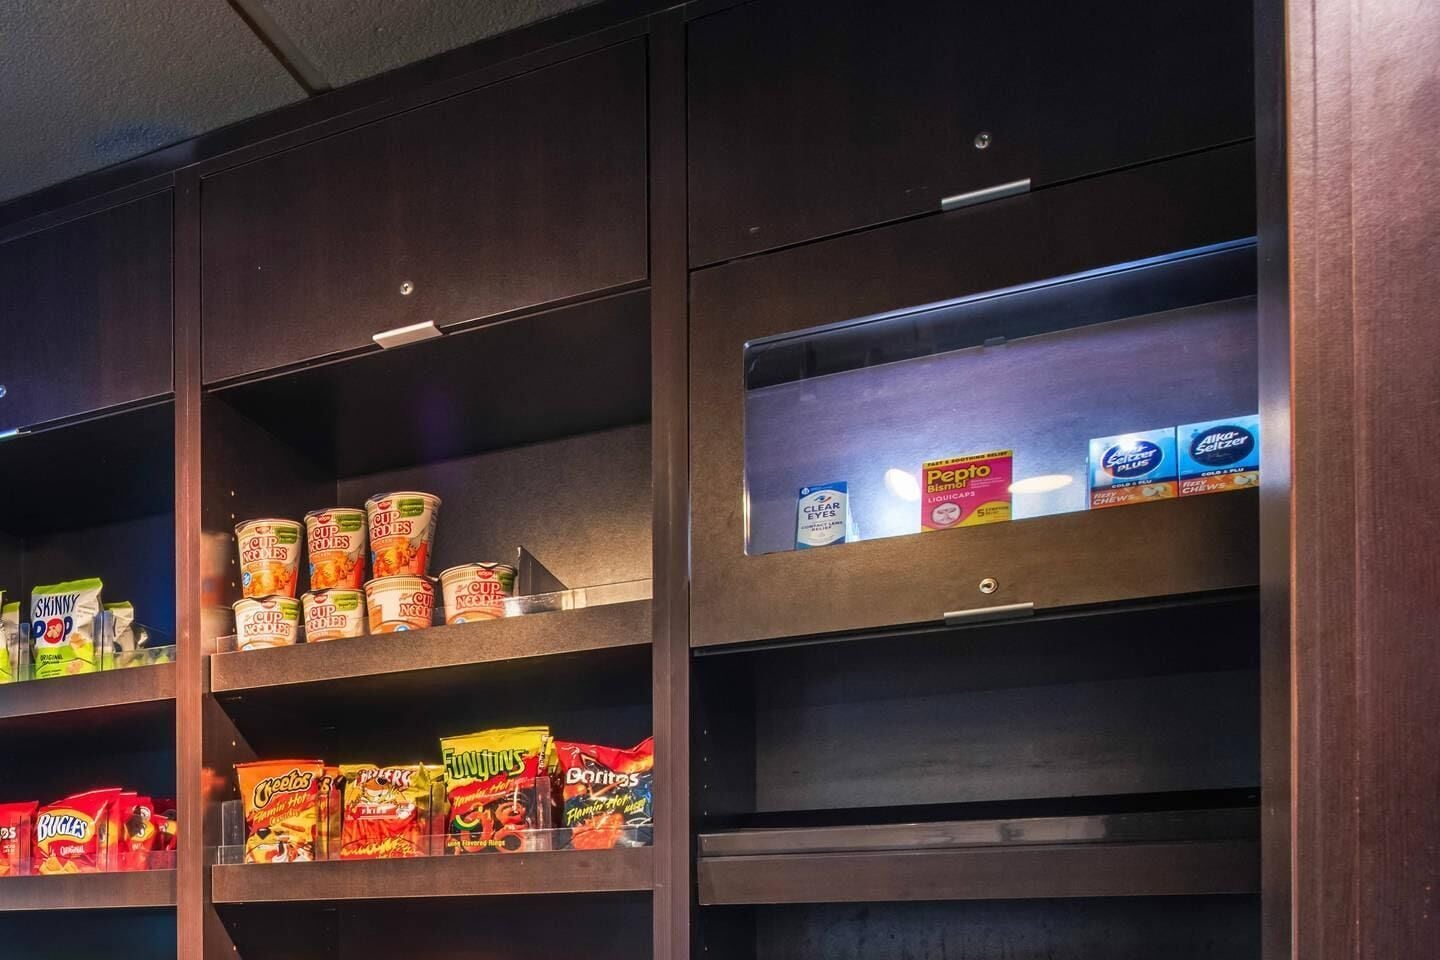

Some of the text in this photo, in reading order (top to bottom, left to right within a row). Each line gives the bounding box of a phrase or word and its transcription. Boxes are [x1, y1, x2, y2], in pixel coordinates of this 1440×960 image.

[1201, 430, 1239, 445] Alka-
[1194, 435, 1249, 455] Seltzer
[1106, 448, 1157, 468] Seltzer
[1117, 459, 1150, 472] PLUS
[927, 464, 991, 484] Pepto
[927, 479, 966, 493] Bismol
[1182, 482, 1226, 494] CHEWS
[928, 491, 975, 503] LIQUICAPS
[803, 502, 840, 513] CLEAR
[373, 511, 400, 526] CUP
[807, 510, 836, 520] EYES
[313, 525, 339, 539] CUP
[249, 537, 278, 551] CUP
[243, 547, 287, 563] NOODLES
[468, 581, 501, 595] CUP
[253, 611, 283, 622] CUP
[310, 605, 335, 618] CUP
[32, 616, 73, 644] POP
[244, 621, 290, 636] NOODLES
[443, 748, 526, 783] FUNYUNS
[566, 768, 639, 788] Doritos
[254, 768, 313, 809] Cheetos
[288, 793, 308, 807] Hot
[606, 794, 630, 807] Hot
[37, 814, 88, 843] BUGLES
[461, 839, 505, 847] Flavored Rings
